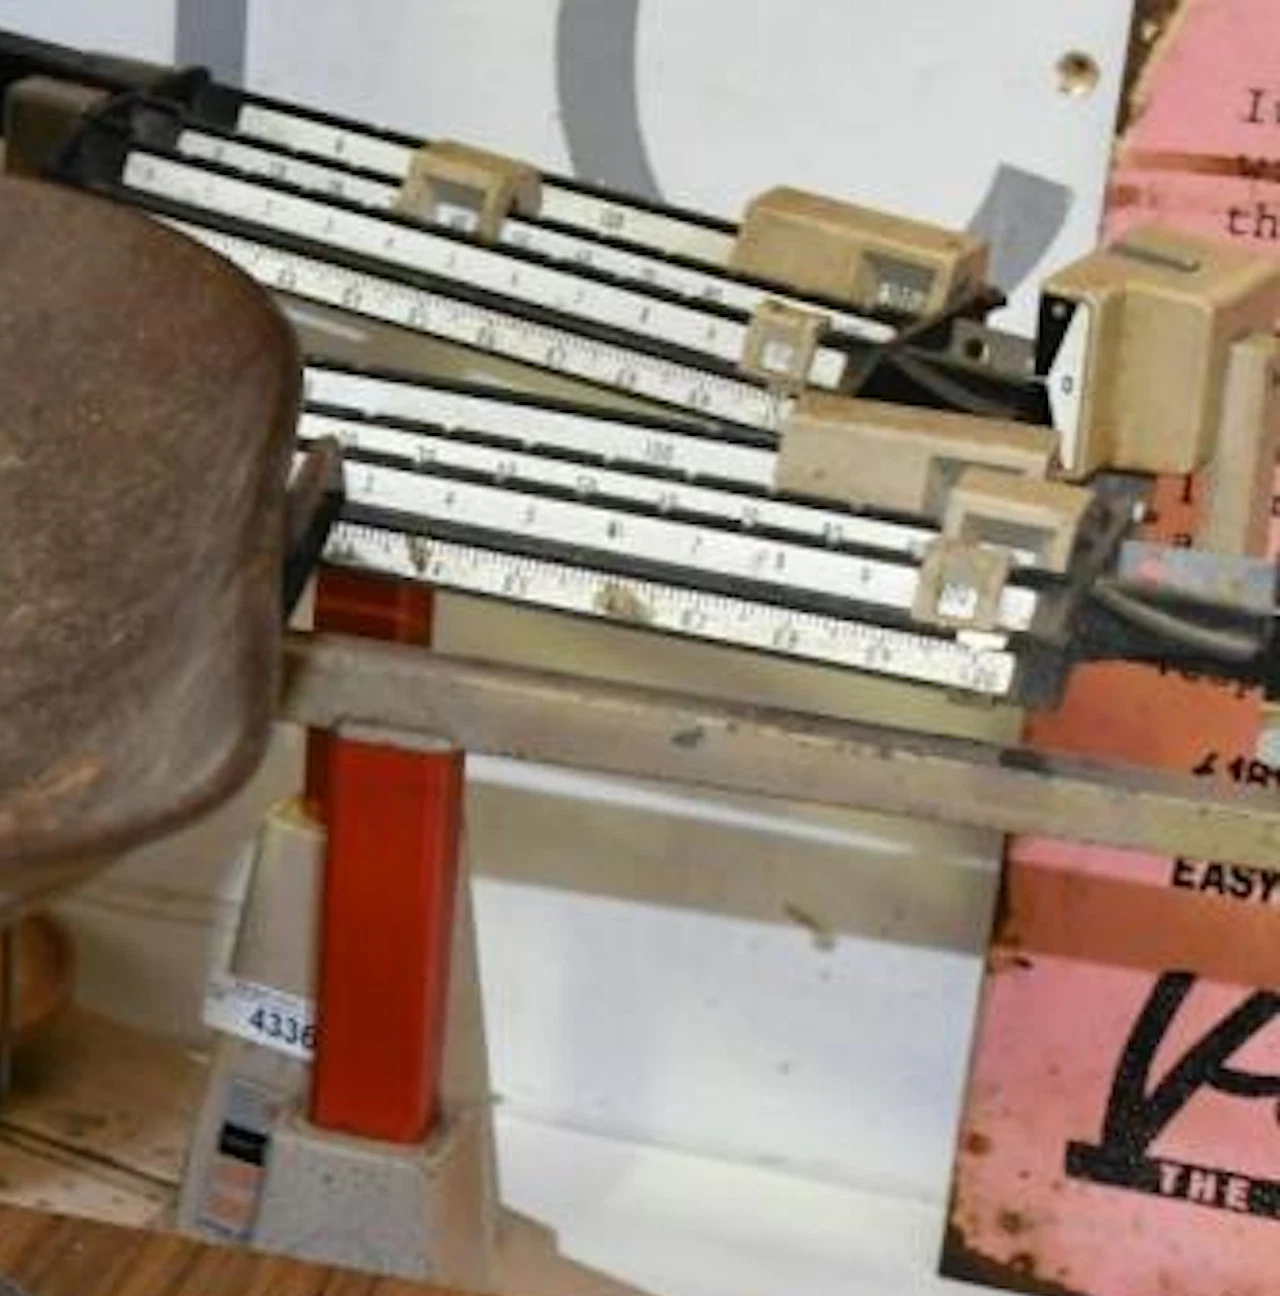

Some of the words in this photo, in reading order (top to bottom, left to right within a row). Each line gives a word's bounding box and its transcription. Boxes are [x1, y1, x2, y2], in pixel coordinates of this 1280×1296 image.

[1170, 855, 1280, 903] EASY
[248, 1004, 319, 1049] 4336
[1158, 1162, 1251, 1212] THE
